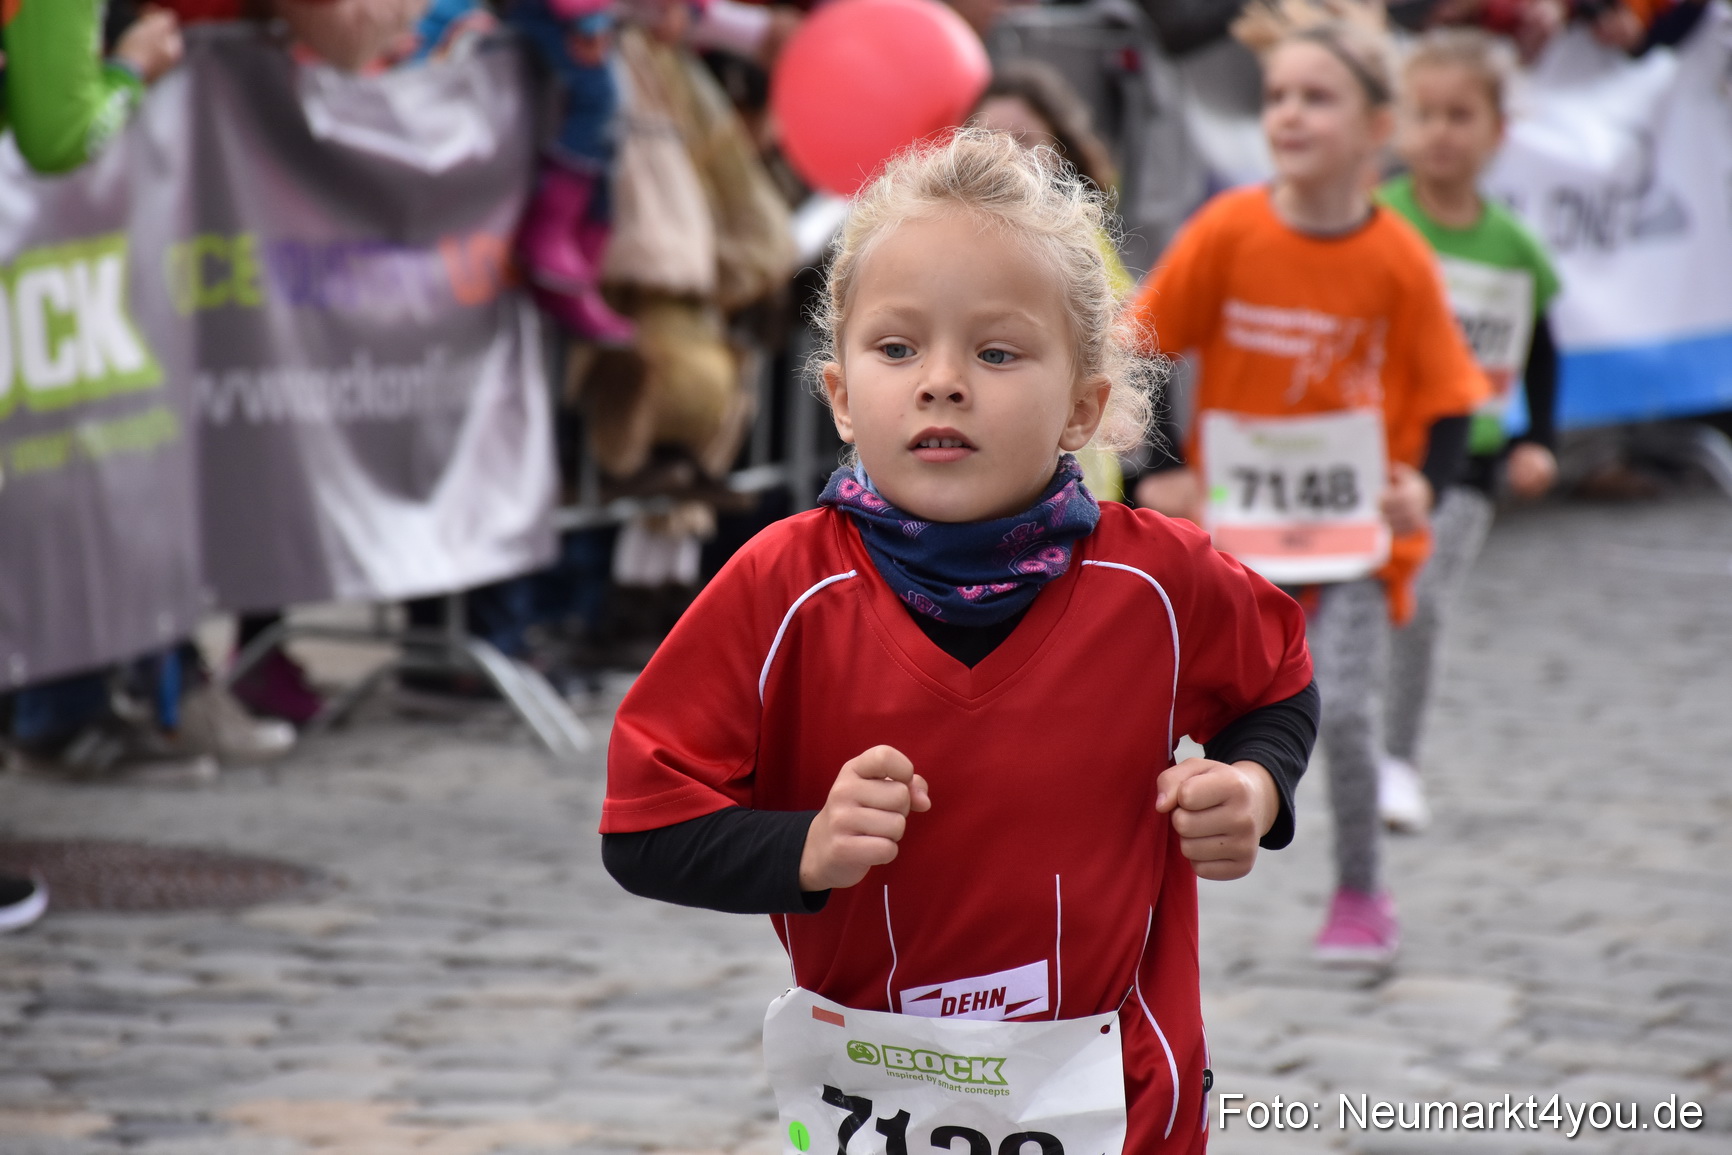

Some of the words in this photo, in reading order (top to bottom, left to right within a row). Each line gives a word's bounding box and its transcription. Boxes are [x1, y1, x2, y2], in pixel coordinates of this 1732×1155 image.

[1231, 463, 1360, 512] 7148
[940, 986, 1007, 1018] DEHN
[881, 1044, 1009, 1086] BOCK
[886, 1069, 924, 1082] inspired
[925, 1074, 937, 1086] by
[937, 1079, 962, 1093] smart
[964, 1086, 1010, 1098] concepts
